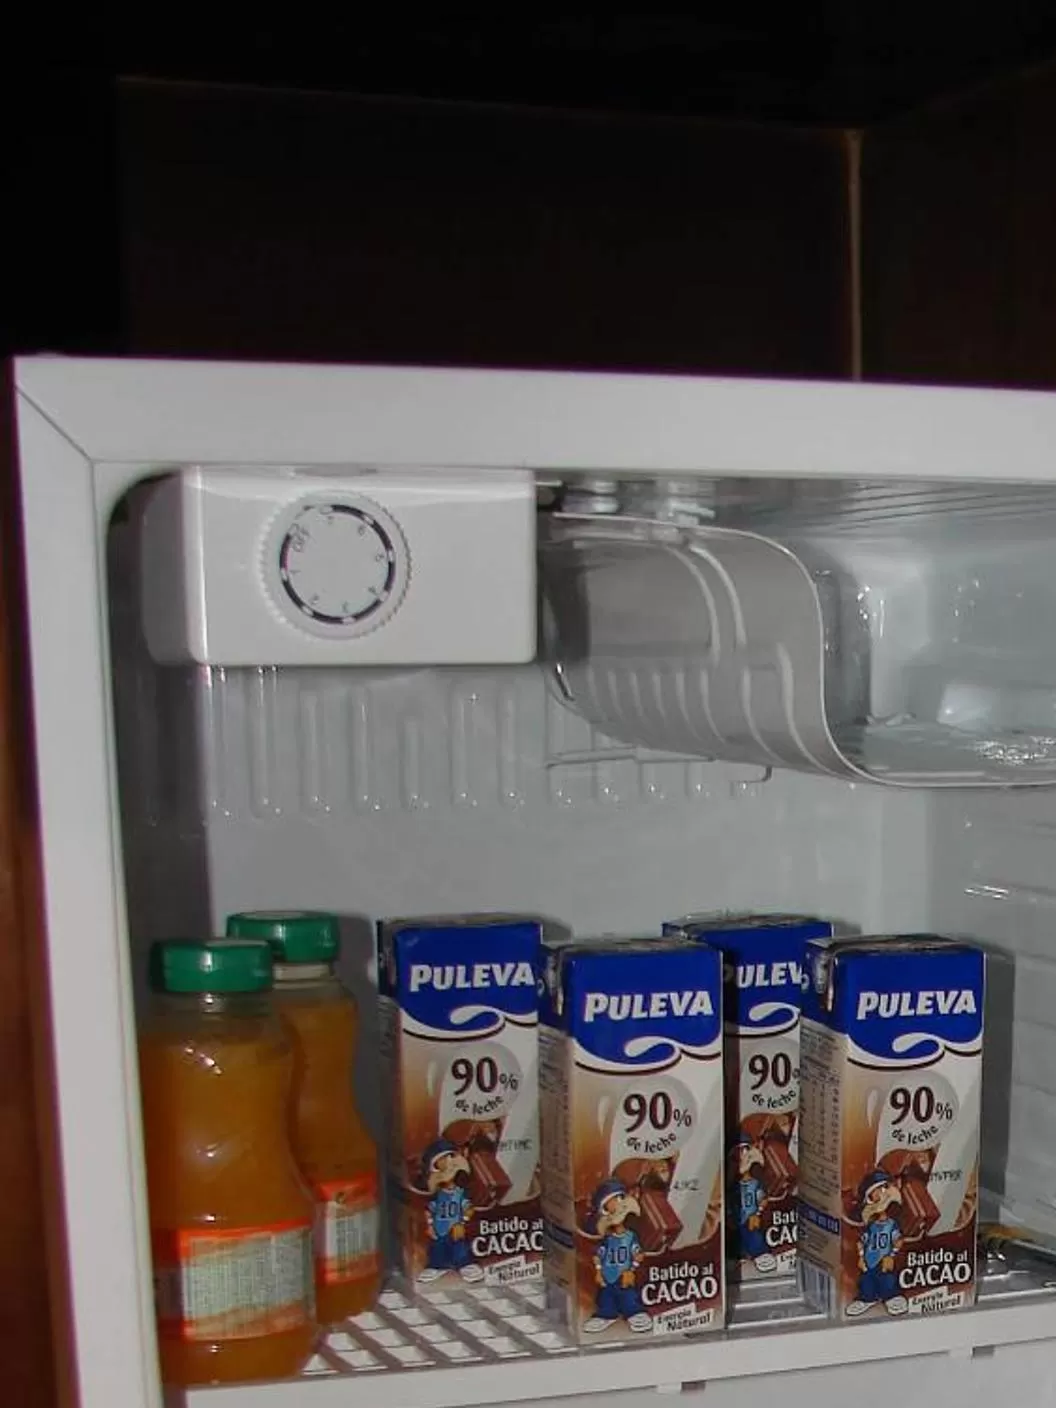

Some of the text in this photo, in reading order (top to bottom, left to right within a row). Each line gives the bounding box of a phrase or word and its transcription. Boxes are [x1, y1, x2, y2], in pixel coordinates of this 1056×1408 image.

[410, 963, 536, 993] PULEVA
[583, 990, 714, 1023] PULEVA
[857, 989, 977, 1021] PULEVA
[451, 1056, 519, 1096] 90%
[455, 1095, 504, 1116] de leche
[623, 1091, 693, 1133] 90%
[890, 1085, 953, 1126] 90%
[626, 1131, 678, 1154] de leche
[891, 1123, 940, 1146] de leche
[479, 1216, 529, 1236] Batido
[873, 1231, 890, 1251] 10
[608, 1246, 629, 1266] 10
[906, 1246, 968, 1267] Batido al
[649, 1261, 714, 1282] Batido al
[898, 1263, 972, 1290] CACAO
[641, 1276, 719, 1306] CACAO
